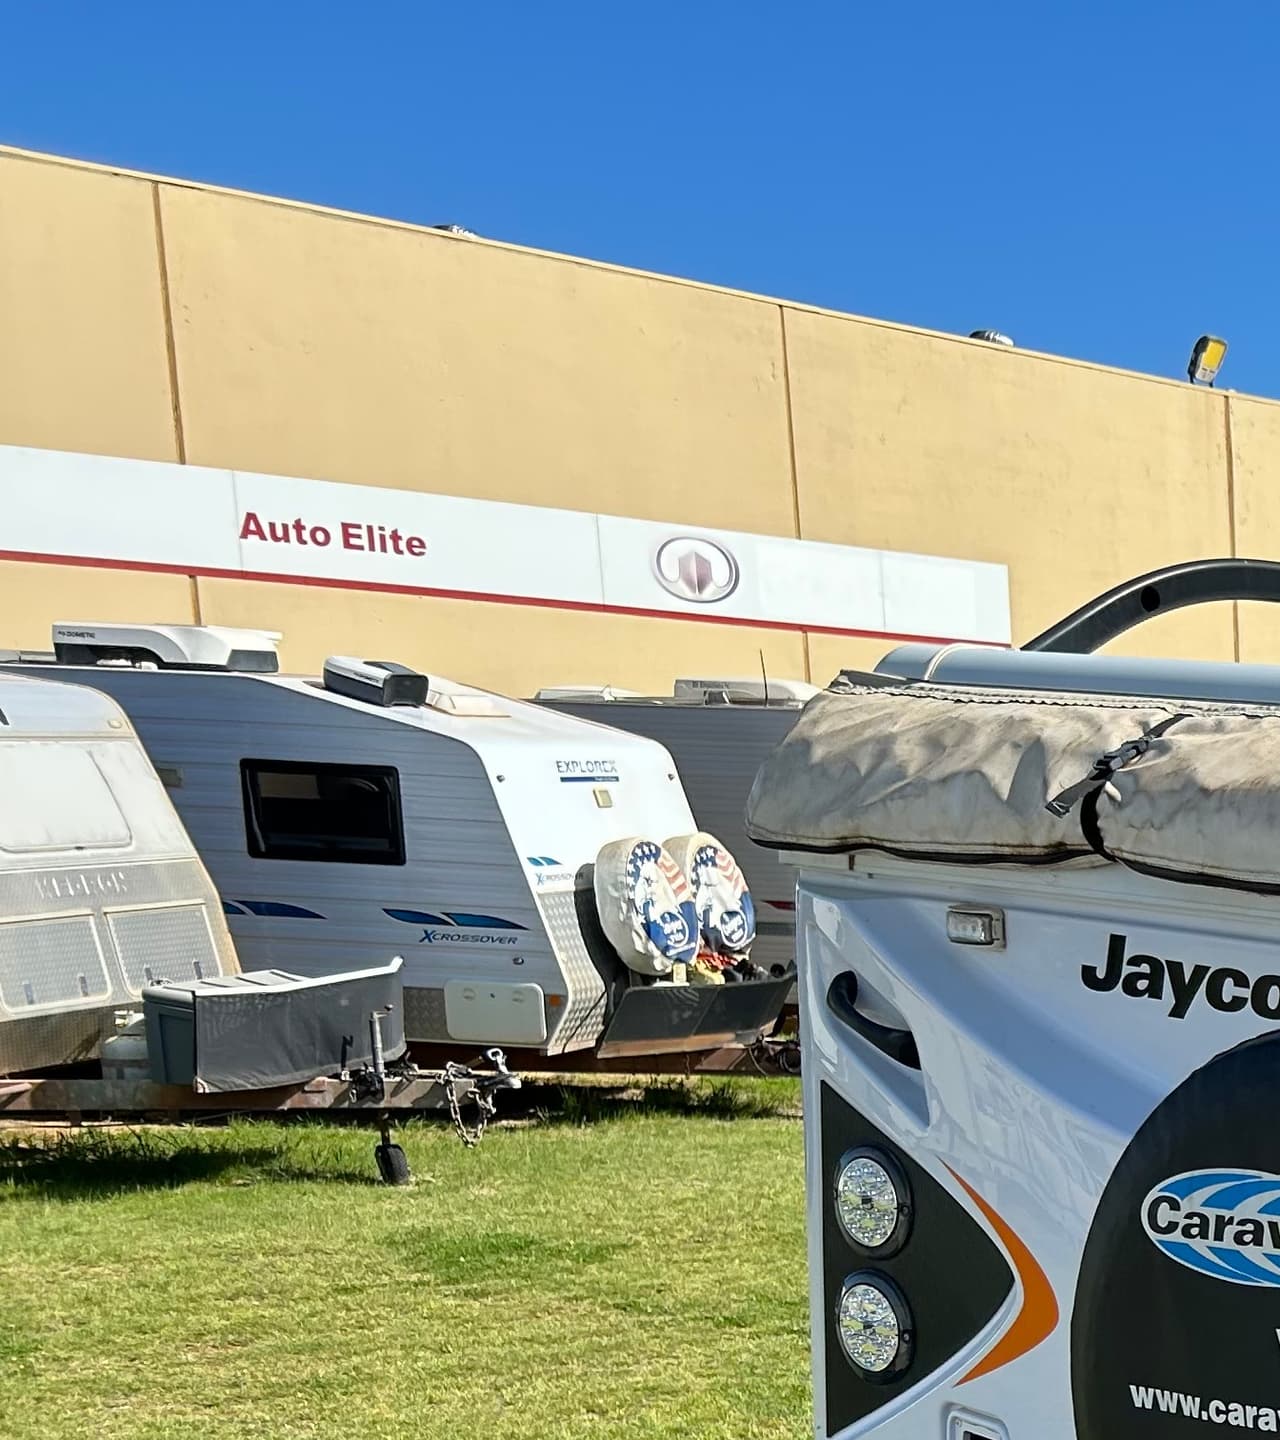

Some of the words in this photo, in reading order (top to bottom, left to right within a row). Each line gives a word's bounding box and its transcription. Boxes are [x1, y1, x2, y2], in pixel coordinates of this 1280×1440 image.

[239, 511, 331, 547] Auto
[340, 521, 427, 557] Elite
[418, 928, 519, 945] XCROSSOVER
